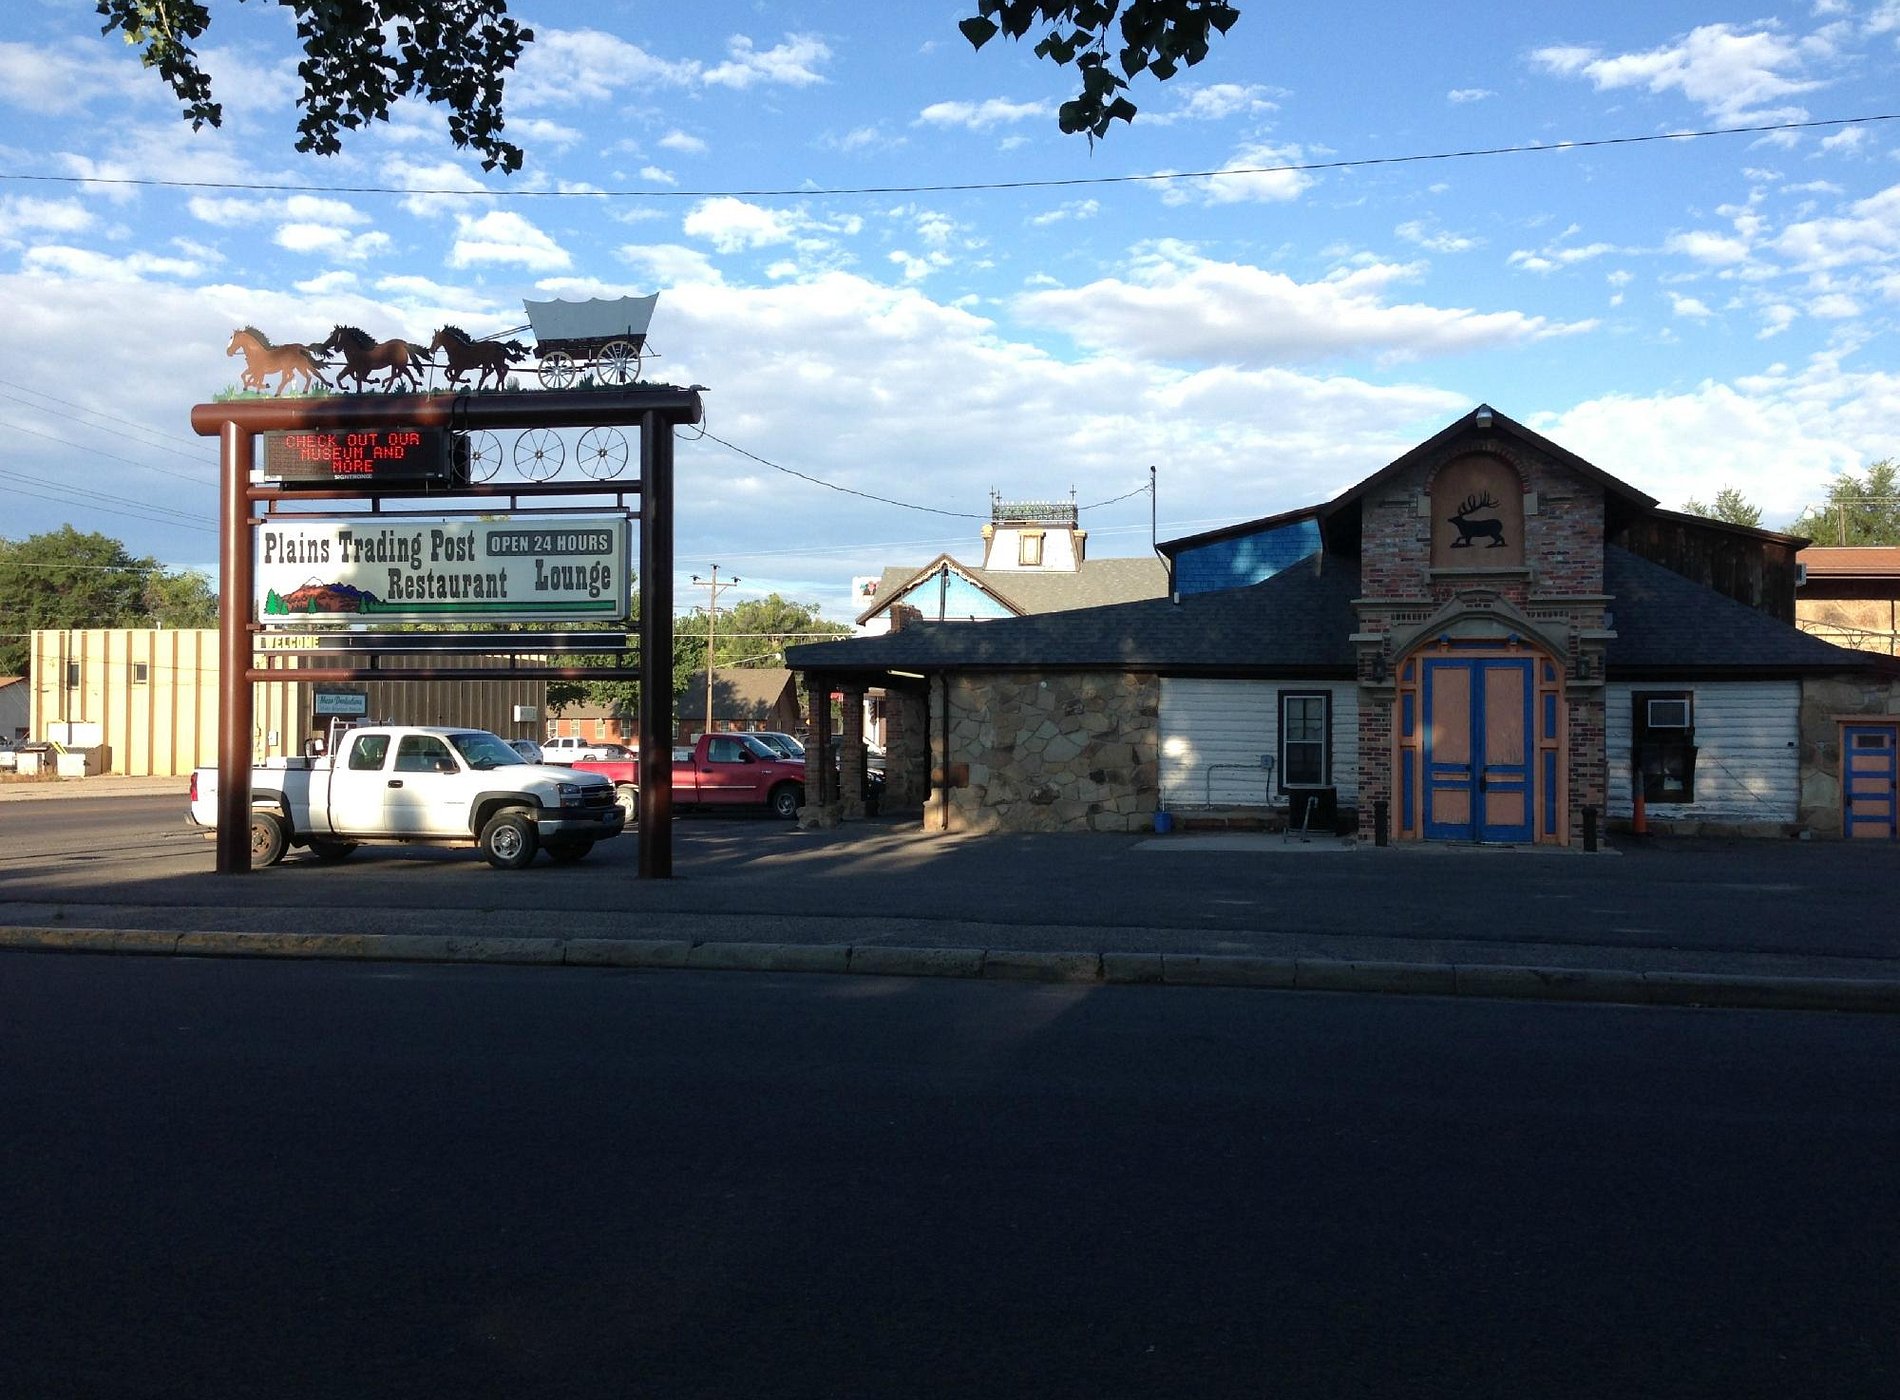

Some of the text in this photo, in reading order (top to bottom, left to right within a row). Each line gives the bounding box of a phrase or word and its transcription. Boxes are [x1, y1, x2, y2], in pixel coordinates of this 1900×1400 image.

[286, 432, 420, 448] CHECK OUT OUR
[301, 446, 405, 461] MUSEUM AND
[332, 460, 374, 473] MORE
[264, 529, 475, 570] Plains Trading Post
[491, 534, 608, 552] OPEN 24 HOURS
[388, 567, 508, 600] Restaurant
[535, 559, 611, 598] Lounge
[265, 636, 320, 649] WELCOME
